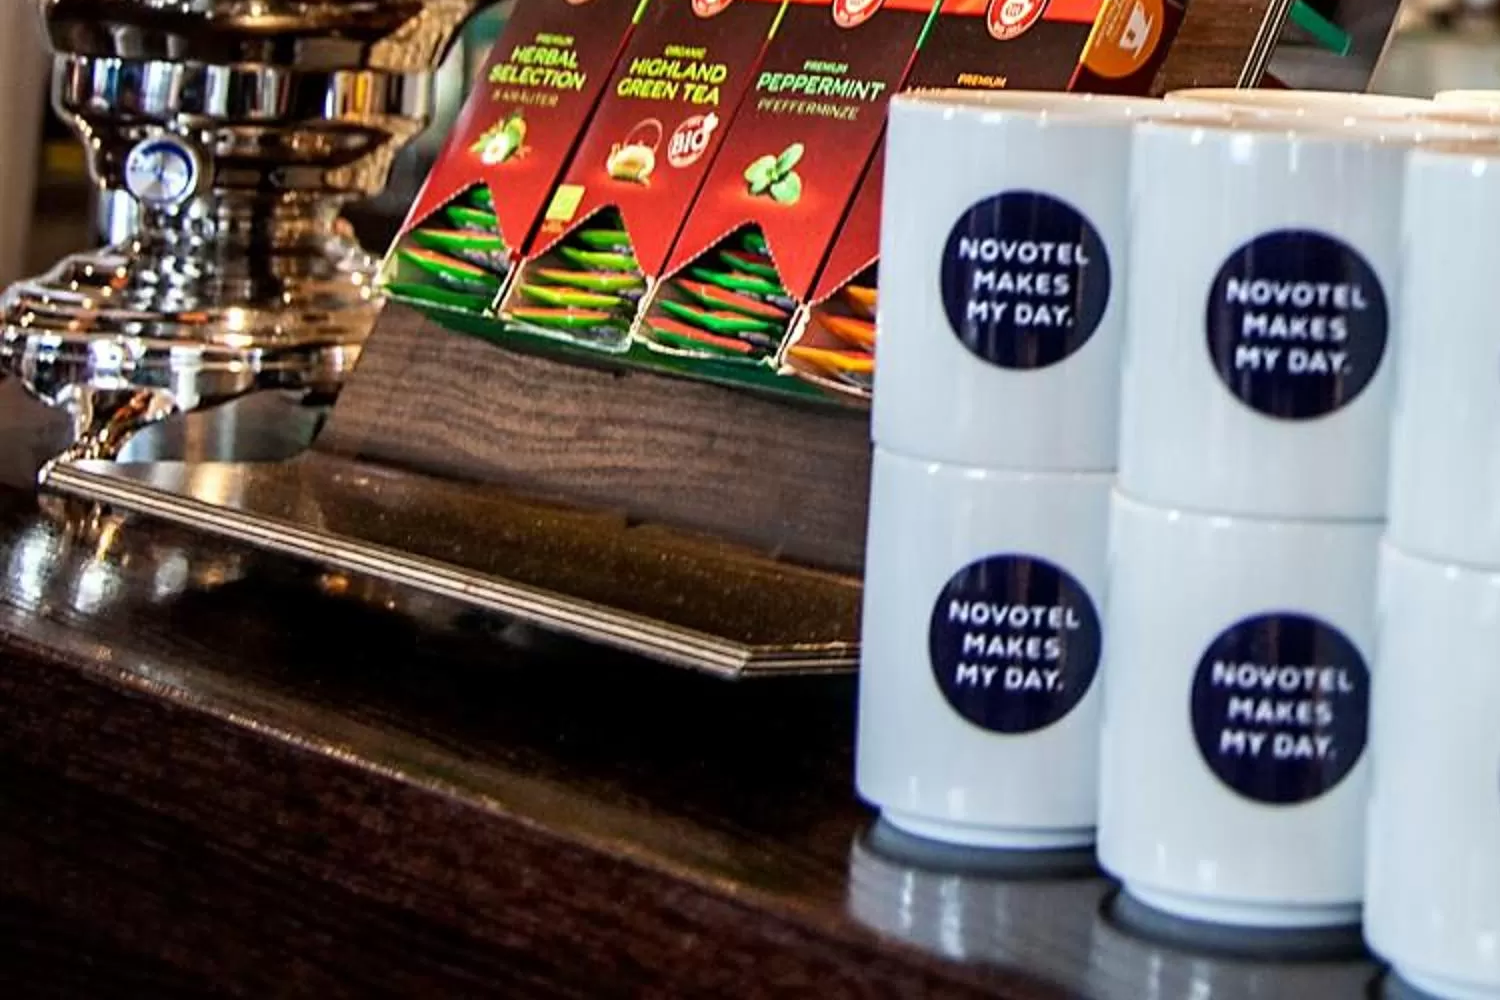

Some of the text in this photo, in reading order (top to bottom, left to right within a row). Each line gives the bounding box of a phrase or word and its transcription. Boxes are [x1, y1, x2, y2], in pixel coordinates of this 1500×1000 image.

[511, 45, 579, 70] HERBAL
[629, 57, 728, 85] HIGHLAND
[489, 63, 587, 92] SELECTION
[756, 71, 886, 103] PEPPERMINT
[617, 78, 720, 107] GREEN TEA
[757, 96, 861, 122] PFEFFERMINZE
[670, 127, 706, 156] BIO
[959, 237, 1090, 265] NOVOTEL
[972, 270, 1070, 296] MAKES
[1226, 277, 1368, 310] NOVOTEL
[967, 300, 1073, 327] MY DAY.
[1242, 312, 1348, 342] MAKES
[1235, 345, 1352, 375] MY DAY.
[949, 600, 1080, 629] NOVOTEL
[963, 632, 1061, 661] MAKES
[955, 663, 1064, 691] MY DAY.
[1211, 660, 1353, 693] NOVOTEL
[1227, 696, 1333, 726] MAKES
[1220, 729, 1336, 761] MY DAY.
